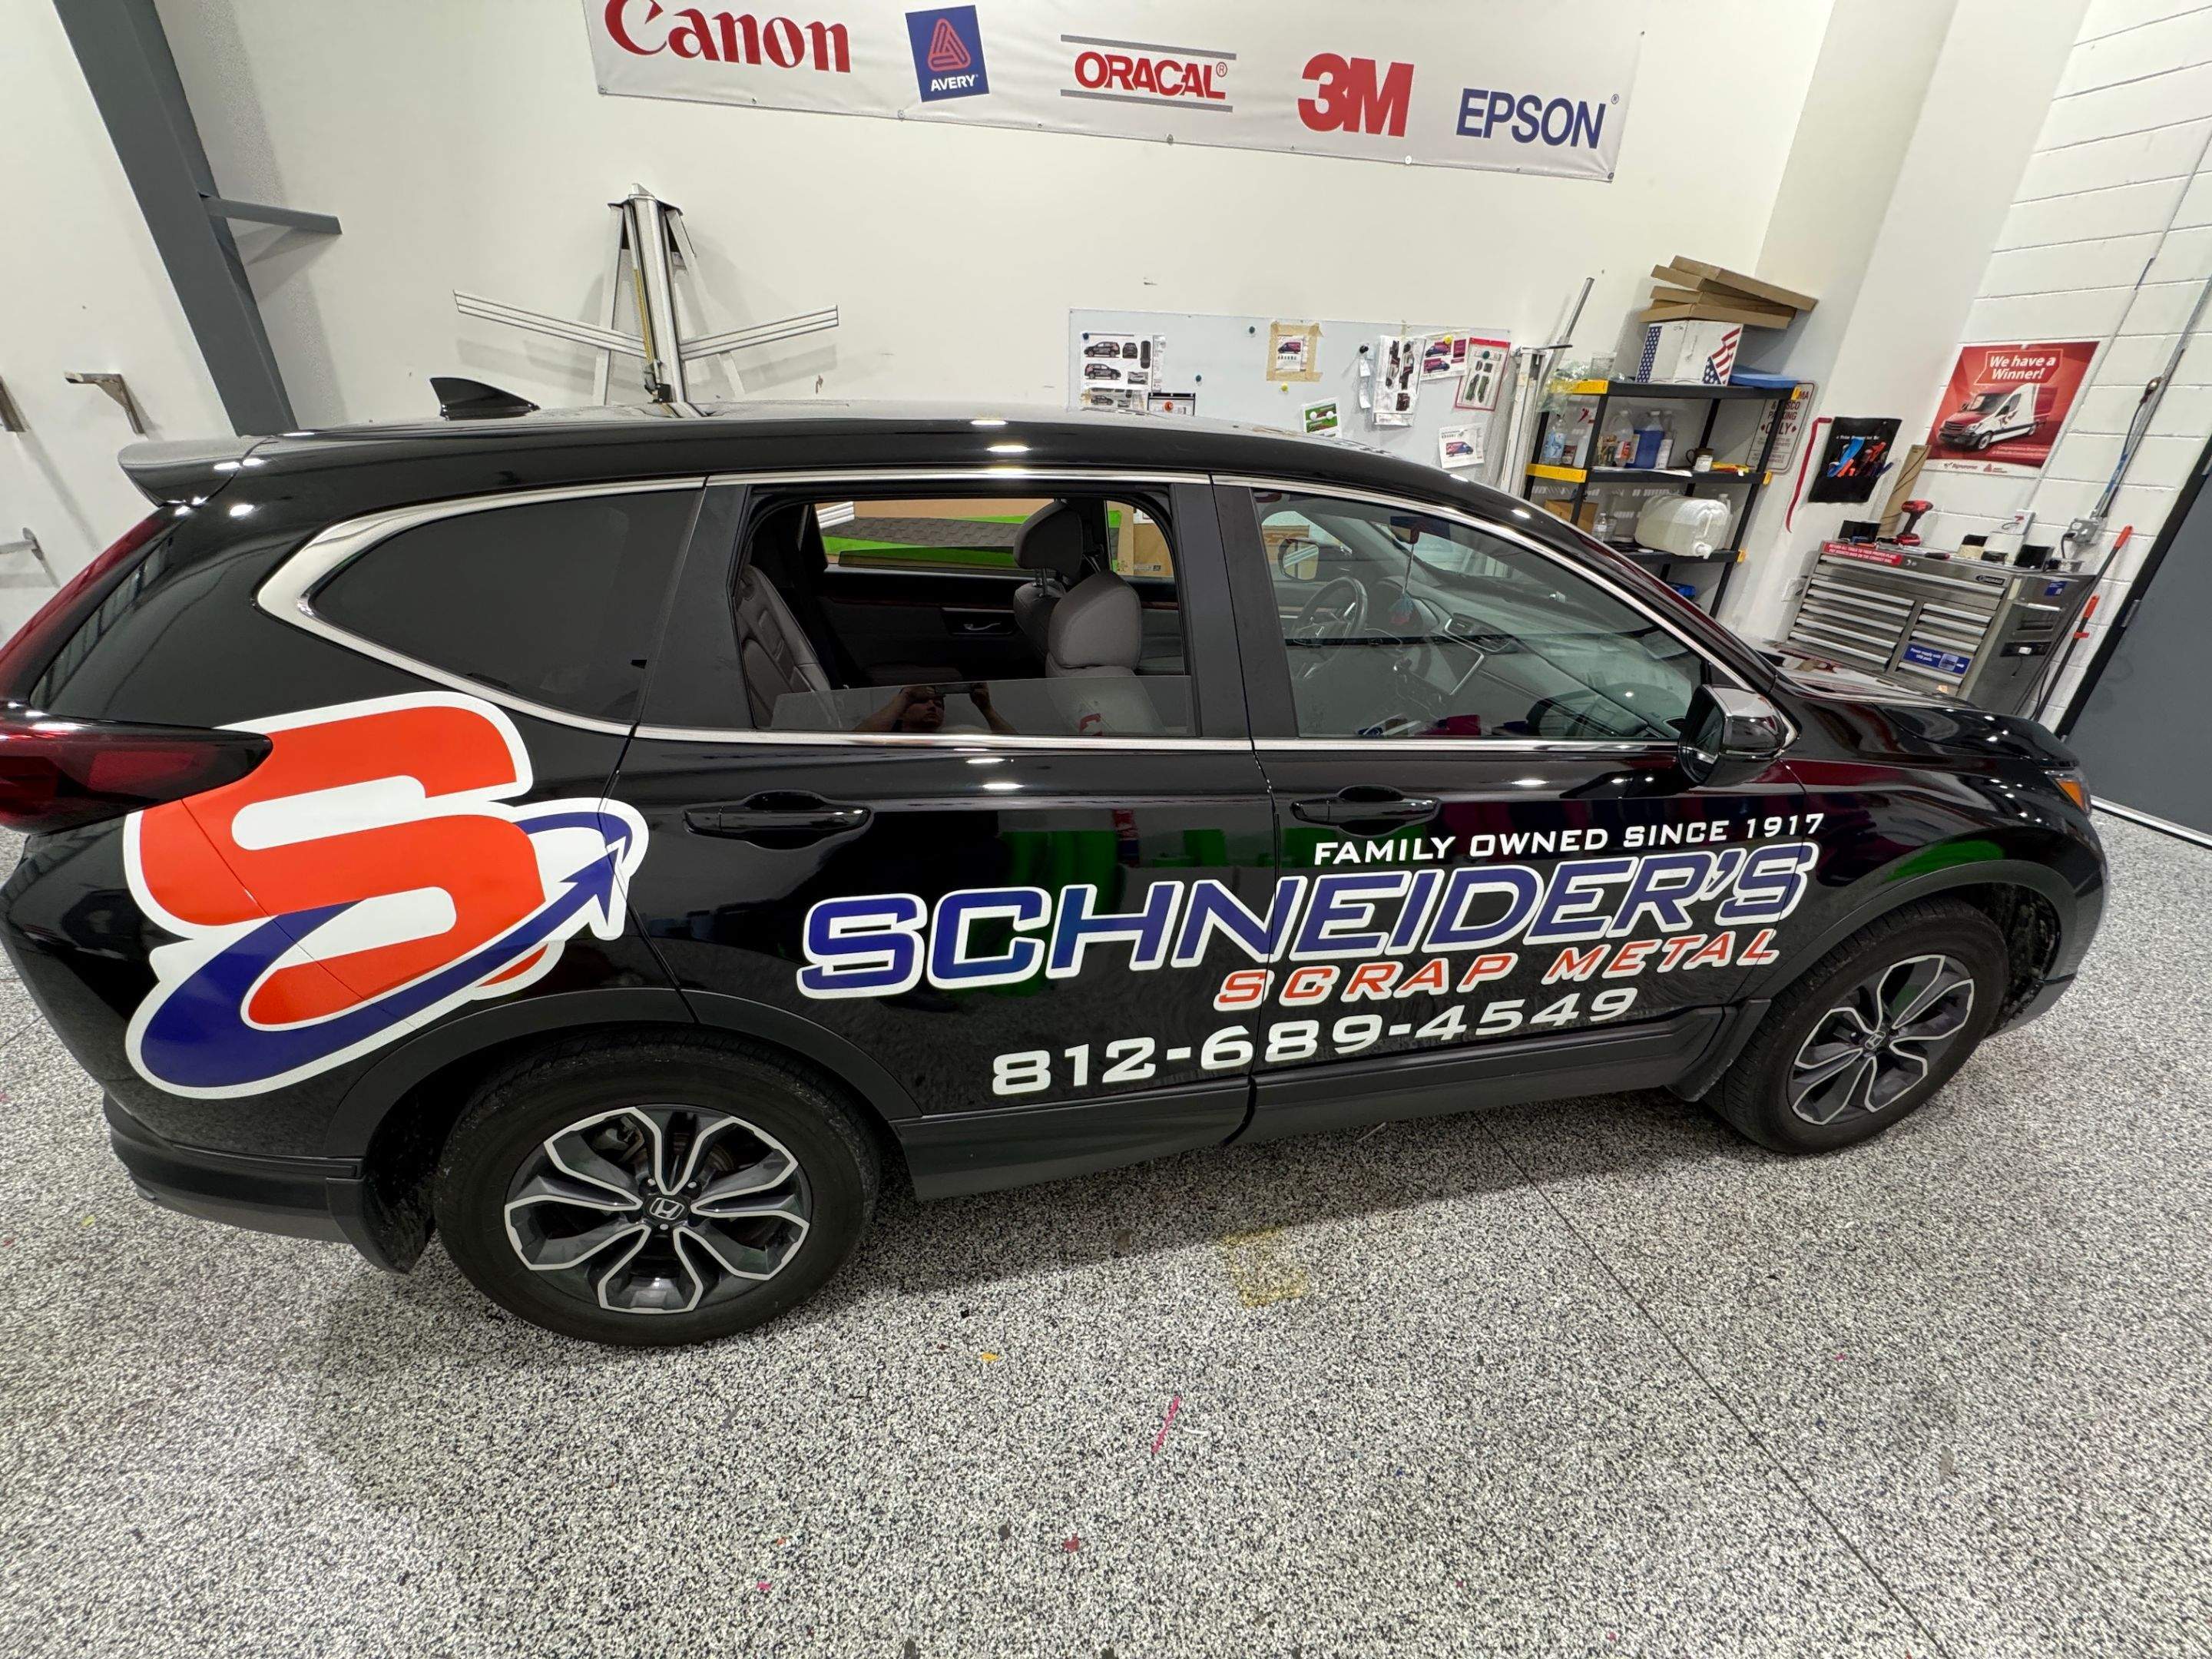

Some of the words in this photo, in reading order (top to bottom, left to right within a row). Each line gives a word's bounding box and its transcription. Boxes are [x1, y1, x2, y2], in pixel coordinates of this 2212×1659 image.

[604, 0, 851, 74] Canon
[930, 75, 979, 91] AVERY
[1298, 53, 1414, 137] 3M
[1989, 356, 2009, 368] We
[2011, 355, 2045, 366] have
[2045, 356, 2057, 366] a
[1992, 367, 2046, 380] Winner!
[1765, 422, 1793, 435] OLY
[1314, 836, 1455, 866] FAMILY
[1469, 827, 1609, 858] OWNED
[1623, 820, 1731, 848] SINCE
[1747, 813, 1826, 839] 1917
[1213, 952, 1518, 1012] SCRAP
[1541, 928, 1780, 985] METAL
[992, 988, 1639, 1095] 812-689-4549
